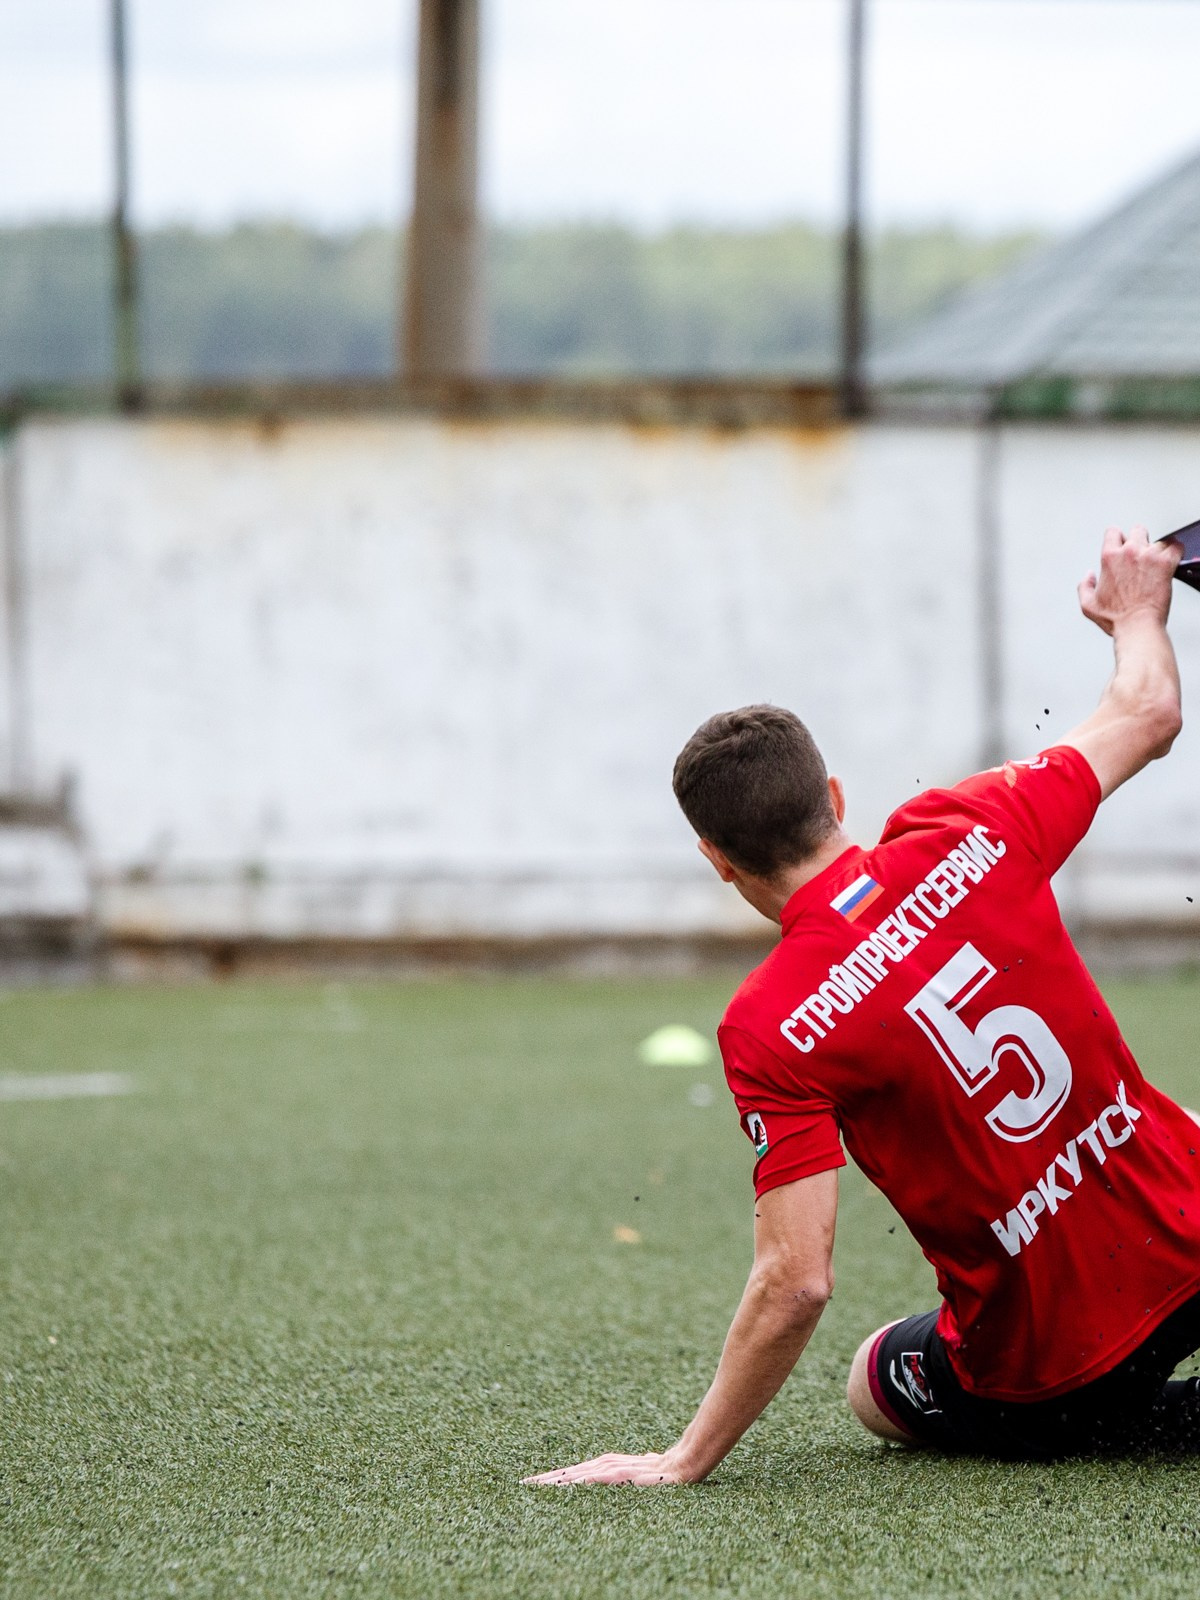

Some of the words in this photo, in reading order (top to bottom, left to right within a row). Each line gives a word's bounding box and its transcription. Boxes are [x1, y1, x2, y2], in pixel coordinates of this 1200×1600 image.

[780, 824, 1007, 1053] СТРОЙПРОЕКТСЕРВИС
[903, 941, 1073, 1143] 5
[990, 1079, 1142, 1257] ИРКУТСК
